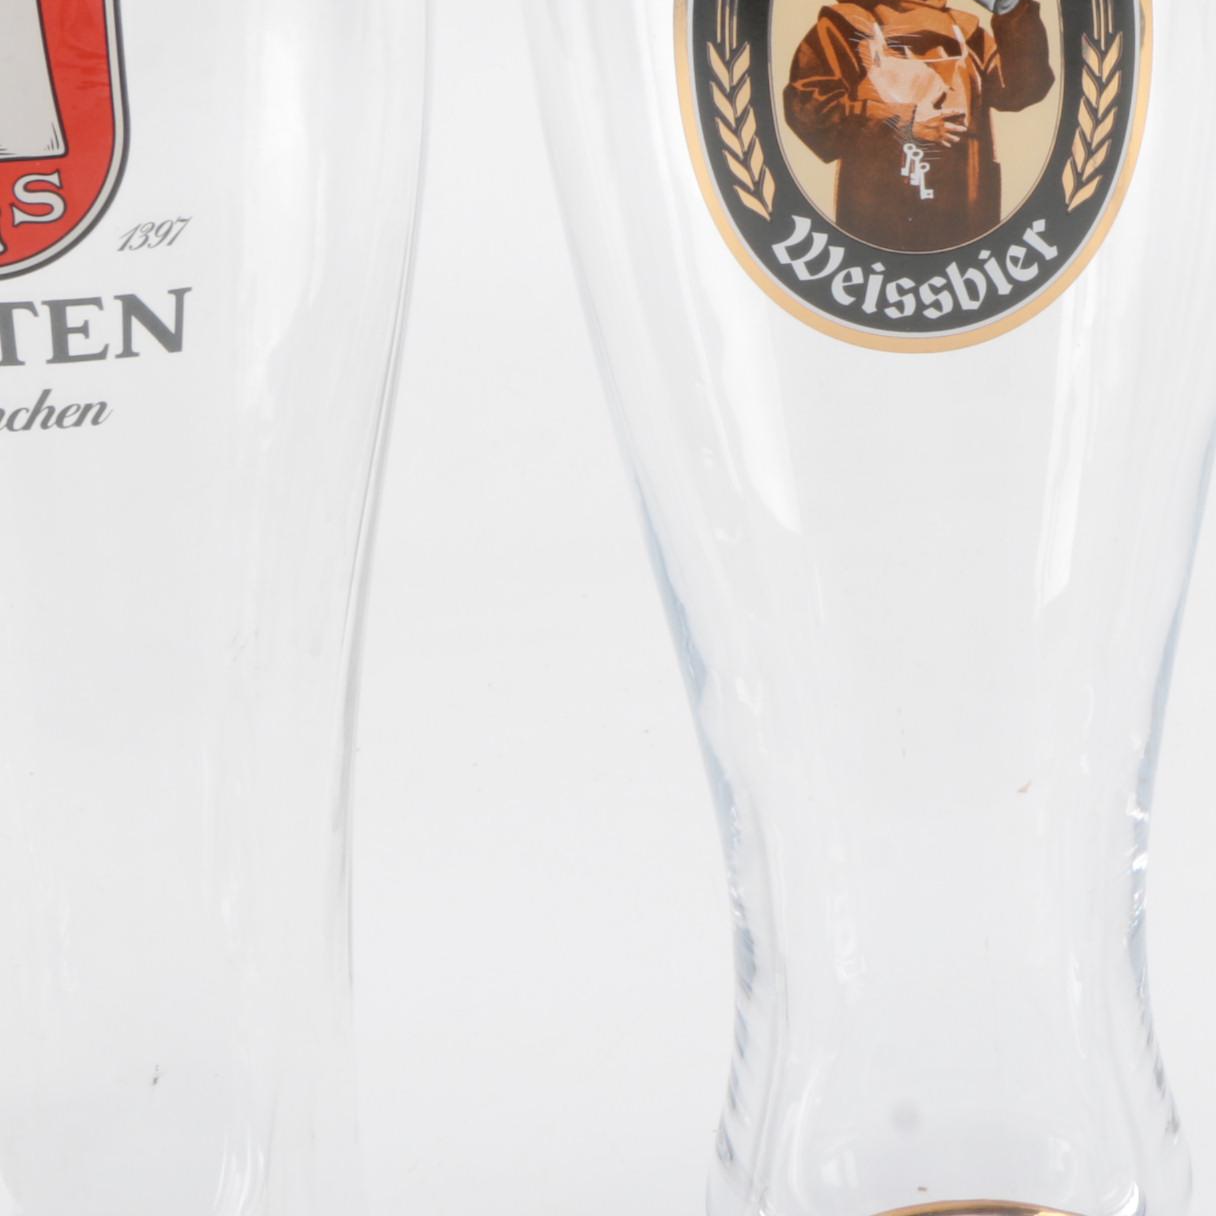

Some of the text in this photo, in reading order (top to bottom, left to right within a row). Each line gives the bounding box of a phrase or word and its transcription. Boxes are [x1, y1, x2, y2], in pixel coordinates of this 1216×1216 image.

[117, 216, 193, 252] 1397
[771, 215, 1061, 320] Weissbier
[0, 388, 114, 432] chen
